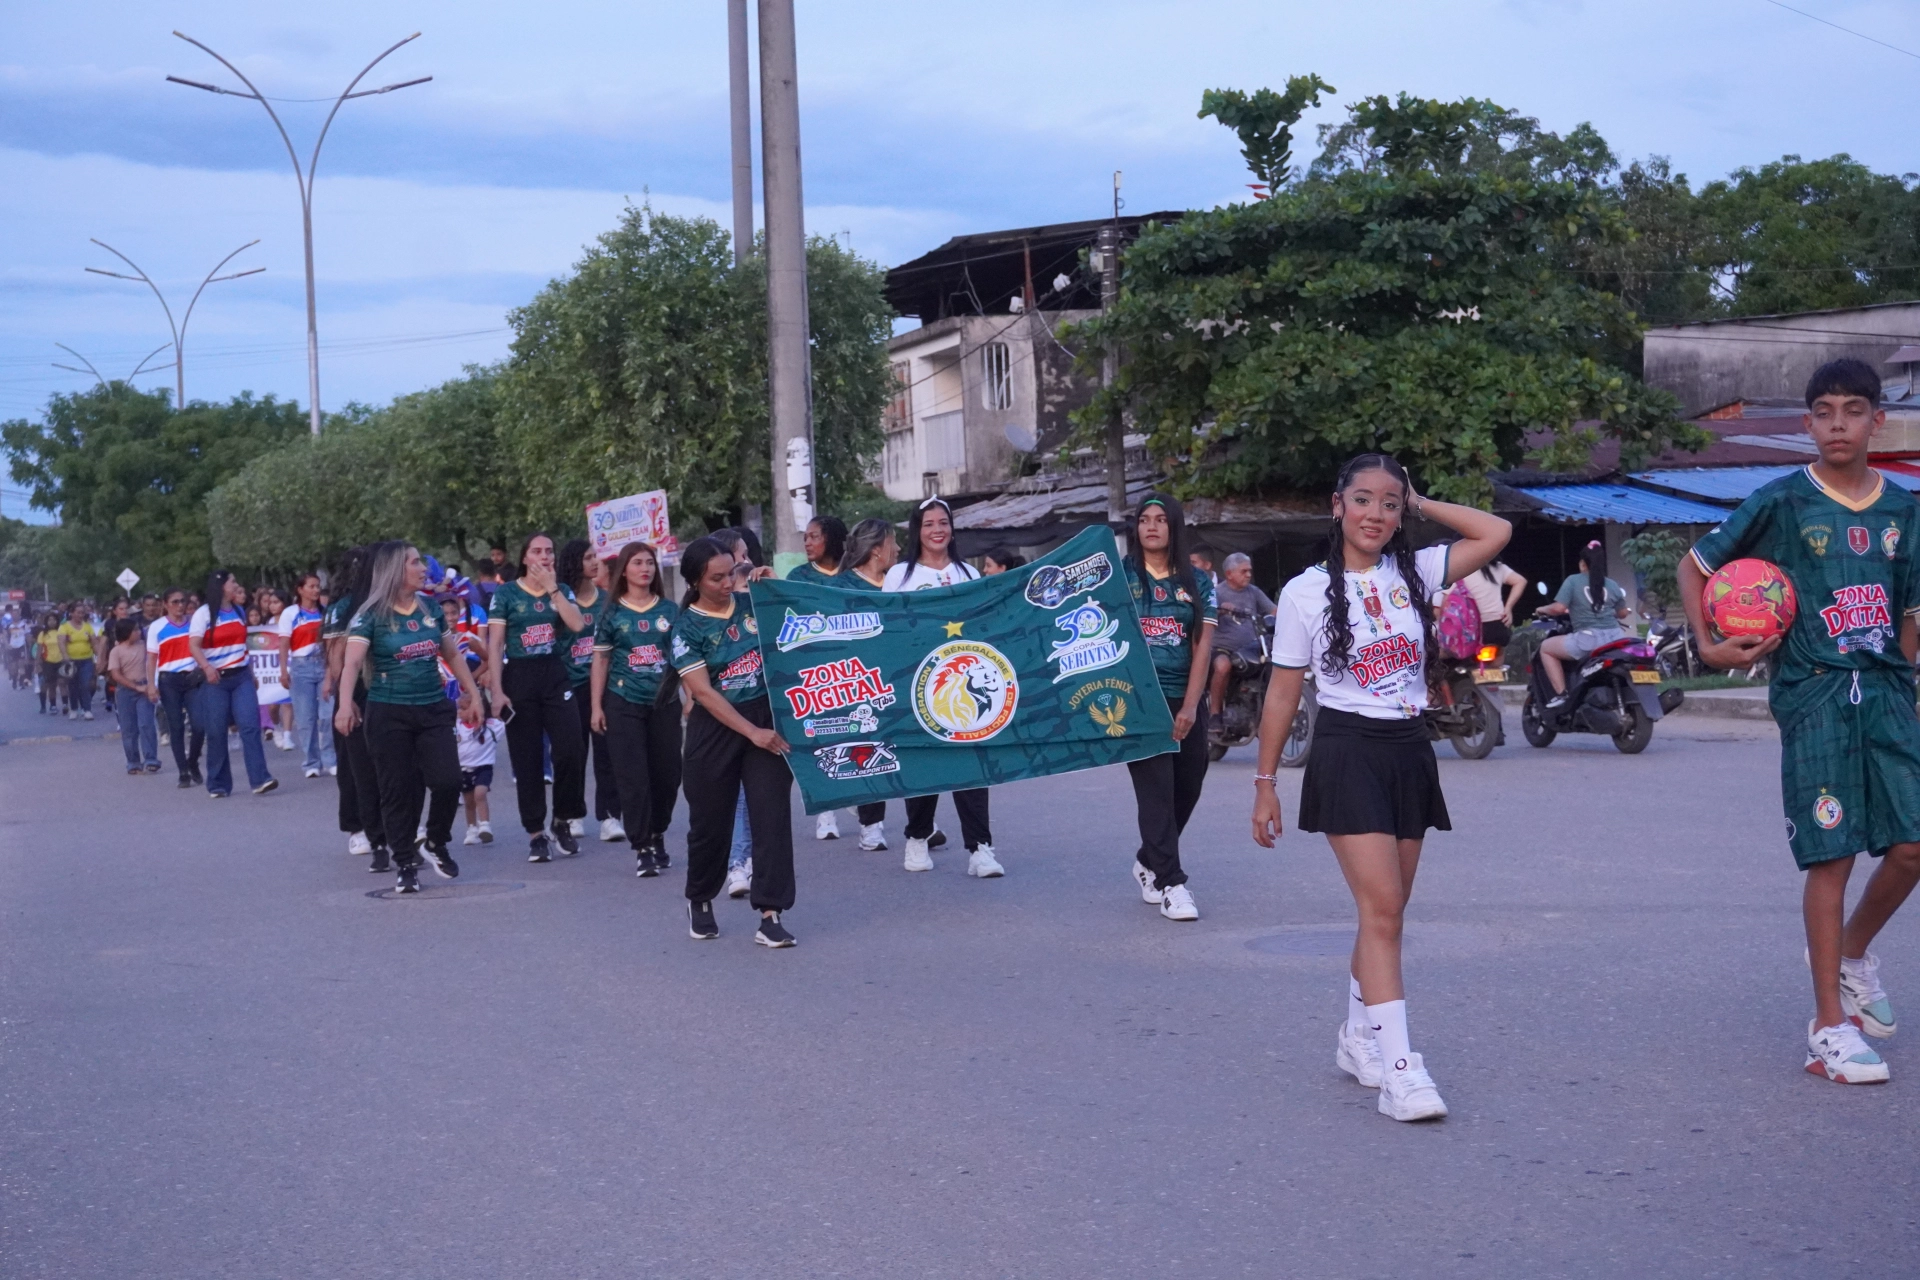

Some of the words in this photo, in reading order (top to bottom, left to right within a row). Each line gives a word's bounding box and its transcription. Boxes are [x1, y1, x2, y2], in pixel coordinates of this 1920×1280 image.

[632, 525, 649, 536] TEAM
[1065, 555, 1107, 581] SANTANDER
[1833, 585, 1888, 608] ZONA
[828, 613, 880, 631] SERINTSA
[1053, 606, 1106, 647] 30
[1820, 605, 1891, 637] DIGITA
[943, 645, 1009, 675] SÉNÉGALAISE
[1060, 643, 1117, 672] SERINTSA
[1073, 641, 1096, 652] COPA
[1360, 634, 1409, 662] ZONA
[799, 657, 869, 688] ZONA
[1350, 643, 1422, 688] DIGITAL
[786, 668, 893, 718] DIGITAL
[917, 666, 941, 732] FÉDÉRATION
[1006, 692, 1014, 707] DE
[1069, 680, 1104, 710] JOYERIA
[1105, 677, 1133, 694] FÉNIX
[960, 709, 1009, 739] FOOTBALL
[834, 770, 857, 778] TIENDA
[858, 763, 896, 775] DEPORTIVA
